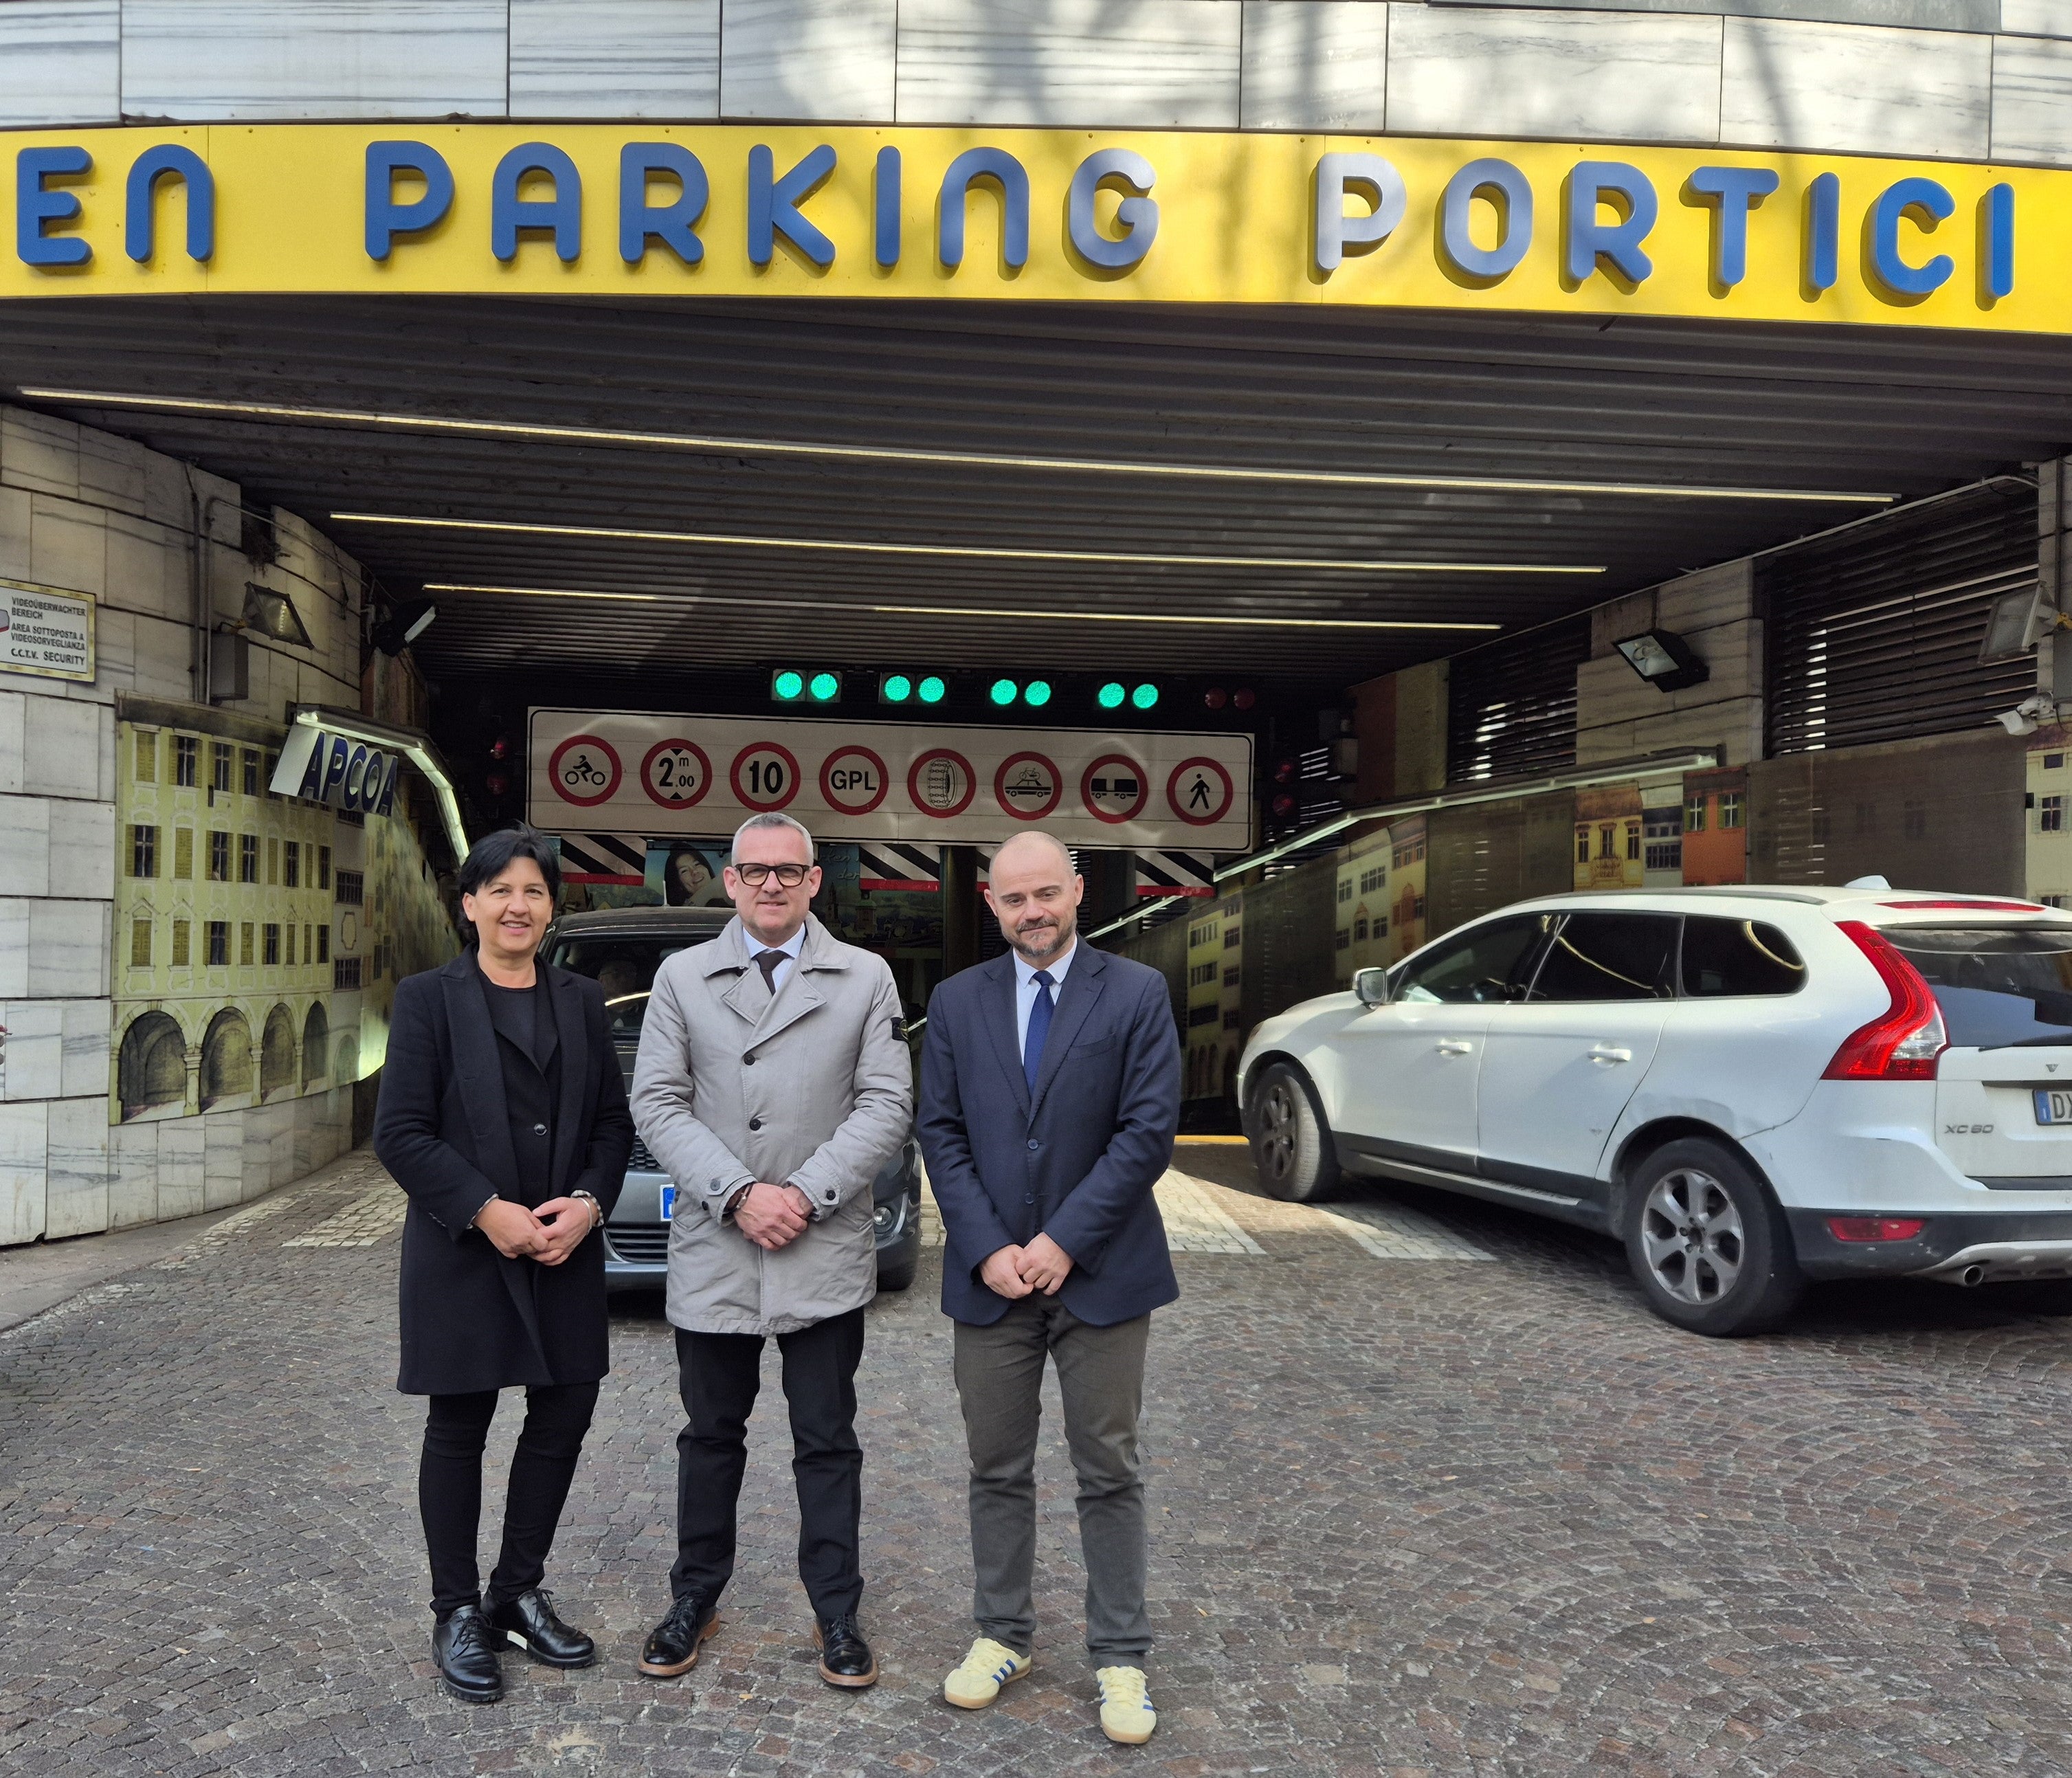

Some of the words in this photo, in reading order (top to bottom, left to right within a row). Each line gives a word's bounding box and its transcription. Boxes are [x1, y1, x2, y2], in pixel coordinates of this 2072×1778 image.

[364, 140, 1159, 271] PARKING
[1315, 152, 2015, 300] PORTICI
[12, 608, 43, 619] BEREICH
[11, 632, 85, 650] VIDEOSORVEGLIANZA
[12, 623, 31, 633] AREA
[32, 625, 78, 640] SOTTOPOSTA
[79, 633, 85, 641] A
[43, 651, 85, 665] SECURITY
[298, 730, 399, 817] APCOA
[748, 760, 783, 794] 10
[830, 769, 877, 791] GPL
